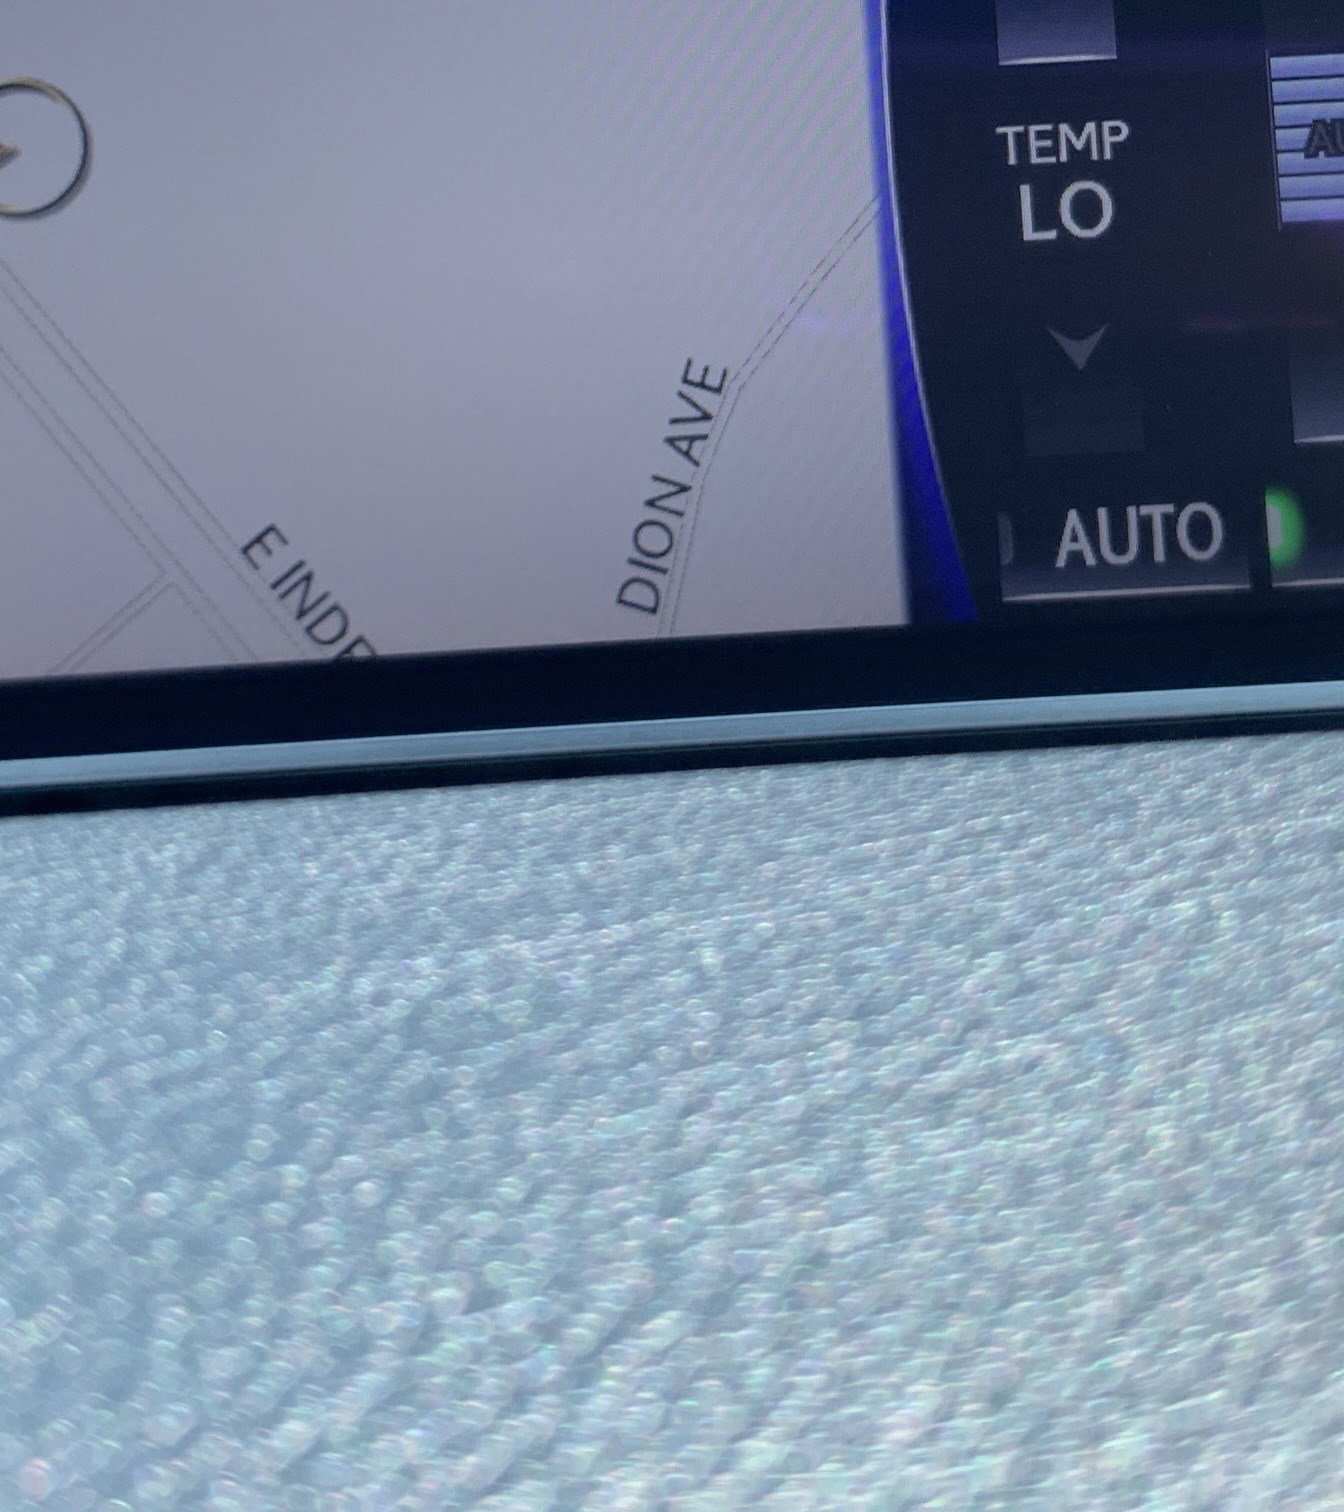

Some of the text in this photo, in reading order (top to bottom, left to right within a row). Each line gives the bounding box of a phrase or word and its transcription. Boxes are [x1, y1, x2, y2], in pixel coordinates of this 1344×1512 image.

[997, 120, 1130, 167] TEMP
[1019, 180, 1115, 244] LO
[614, 356, 728, 616] DION AVE
[241, 523, 289, 571] E
[1055, 501, 1225, 569] AUTO
